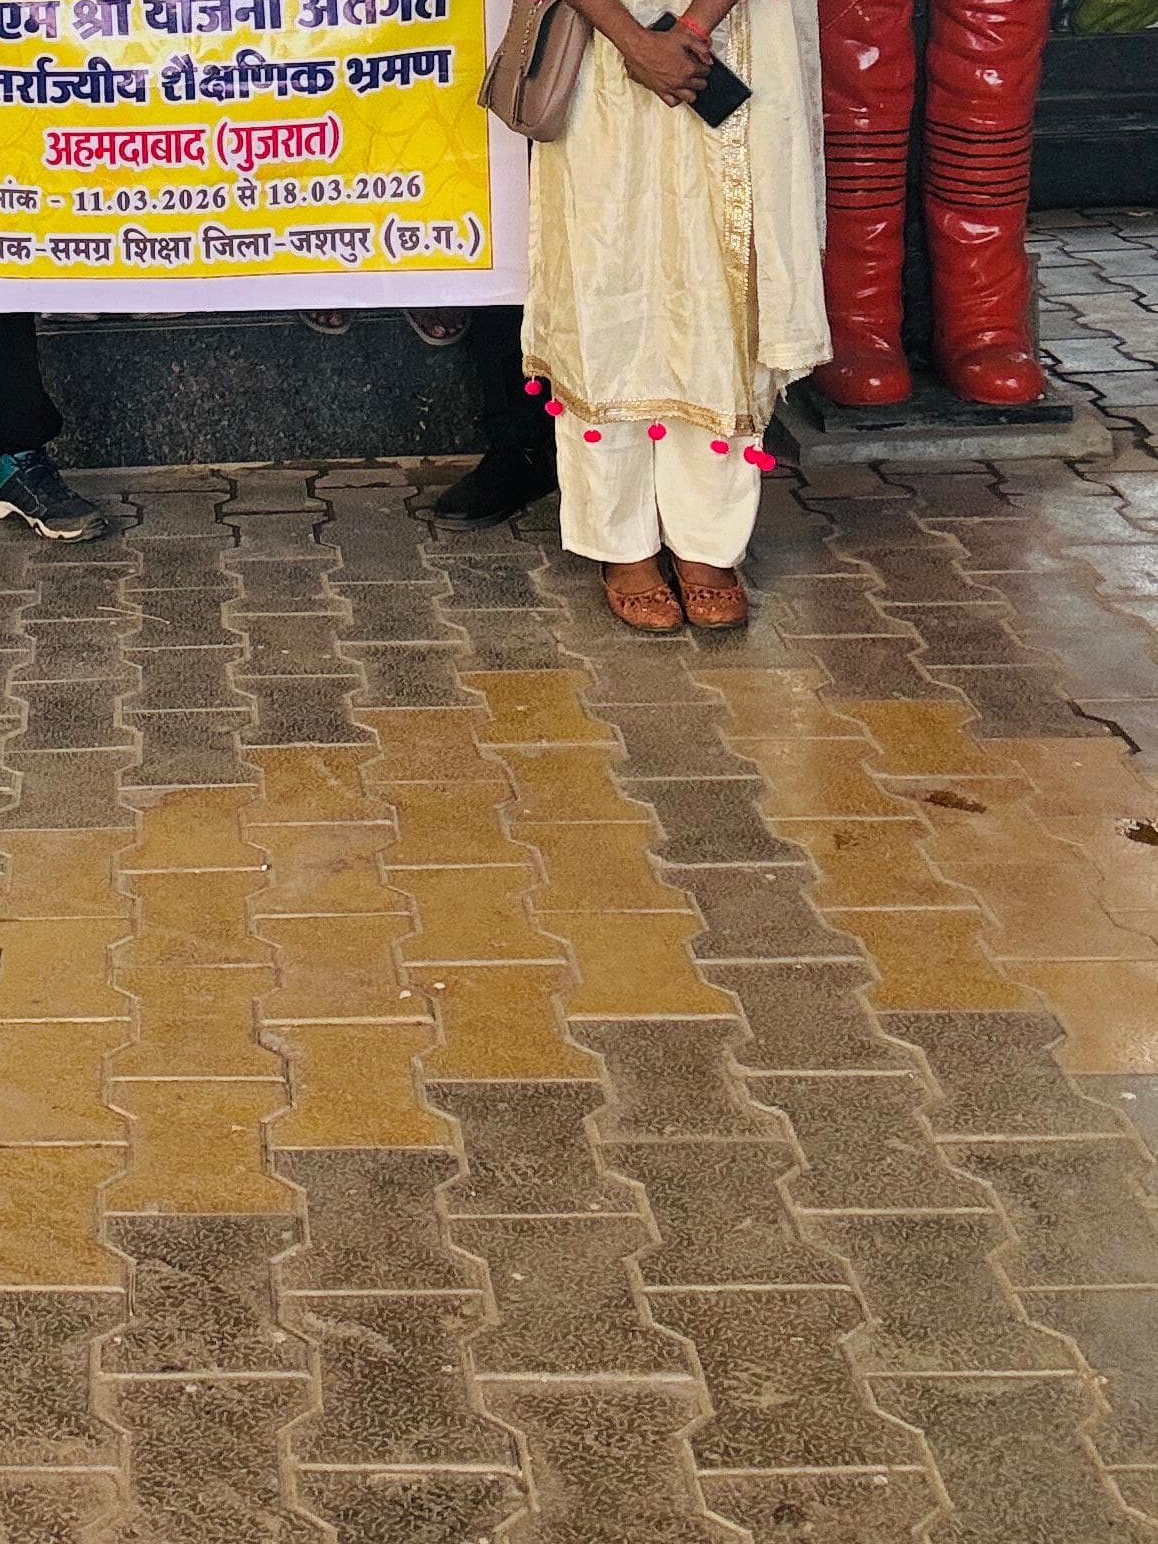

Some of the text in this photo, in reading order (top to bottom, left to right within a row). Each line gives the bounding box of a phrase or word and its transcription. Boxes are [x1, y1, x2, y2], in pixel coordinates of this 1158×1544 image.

[161, 48, 336, 102] शैक्षणिक
[347, 49, 451, 94] भ्रमण
[45, 115, 340, 172] अहमदाबाद (गुजरात)
[75, 185, 227, 212] 11.03.2026
[237, 178, 257, 207] से
[268, 174, 422, 206] 18.03.2026
[123, 227, 192, 262] शिक्षा
[384, 216, 481, 259] (छ.ग.)
